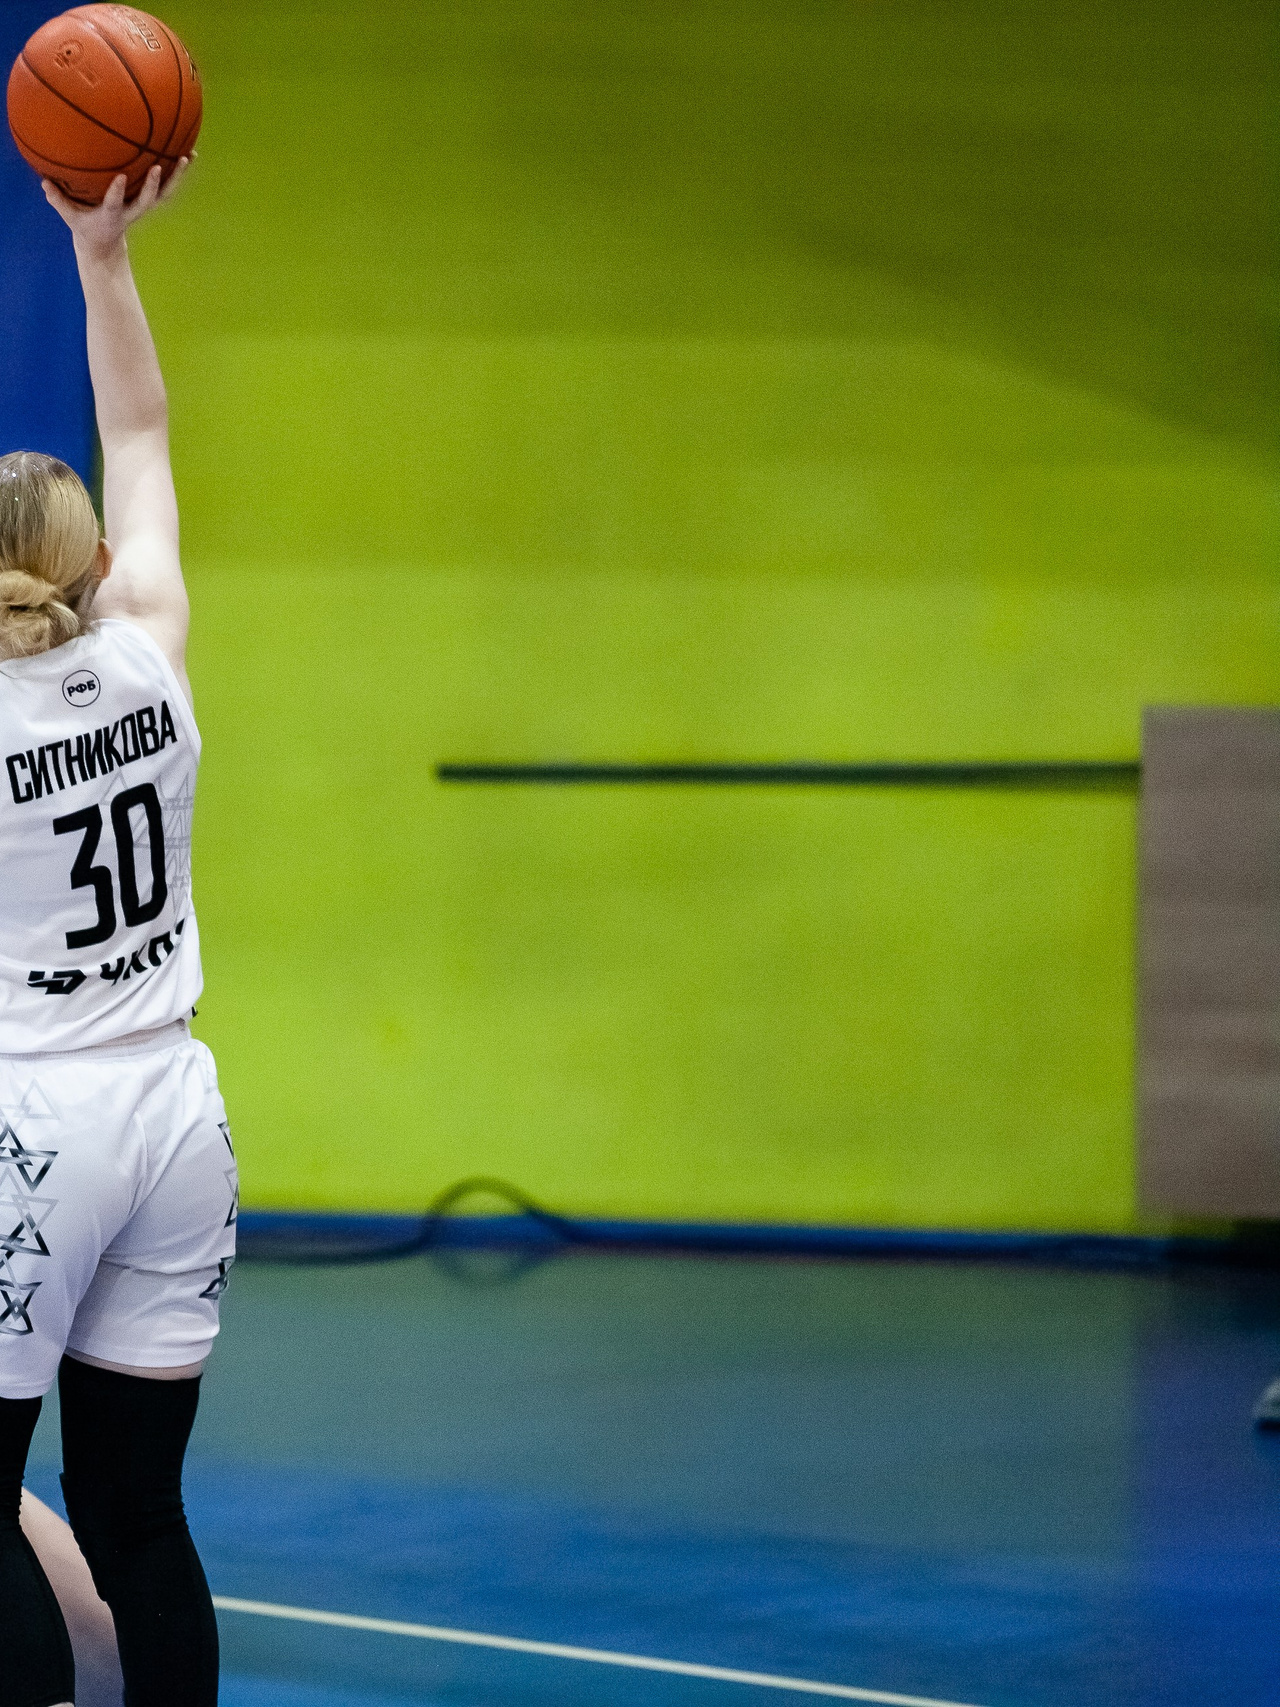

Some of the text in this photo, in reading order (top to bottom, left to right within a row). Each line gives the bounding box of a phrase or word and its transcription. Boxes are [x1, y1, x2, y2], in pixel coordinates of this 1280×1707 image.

[66, 679, 97, 697] РФБ
[5, 700, 178, 804] СИТНИКОВА
[52, 782, 168, 950] 30
